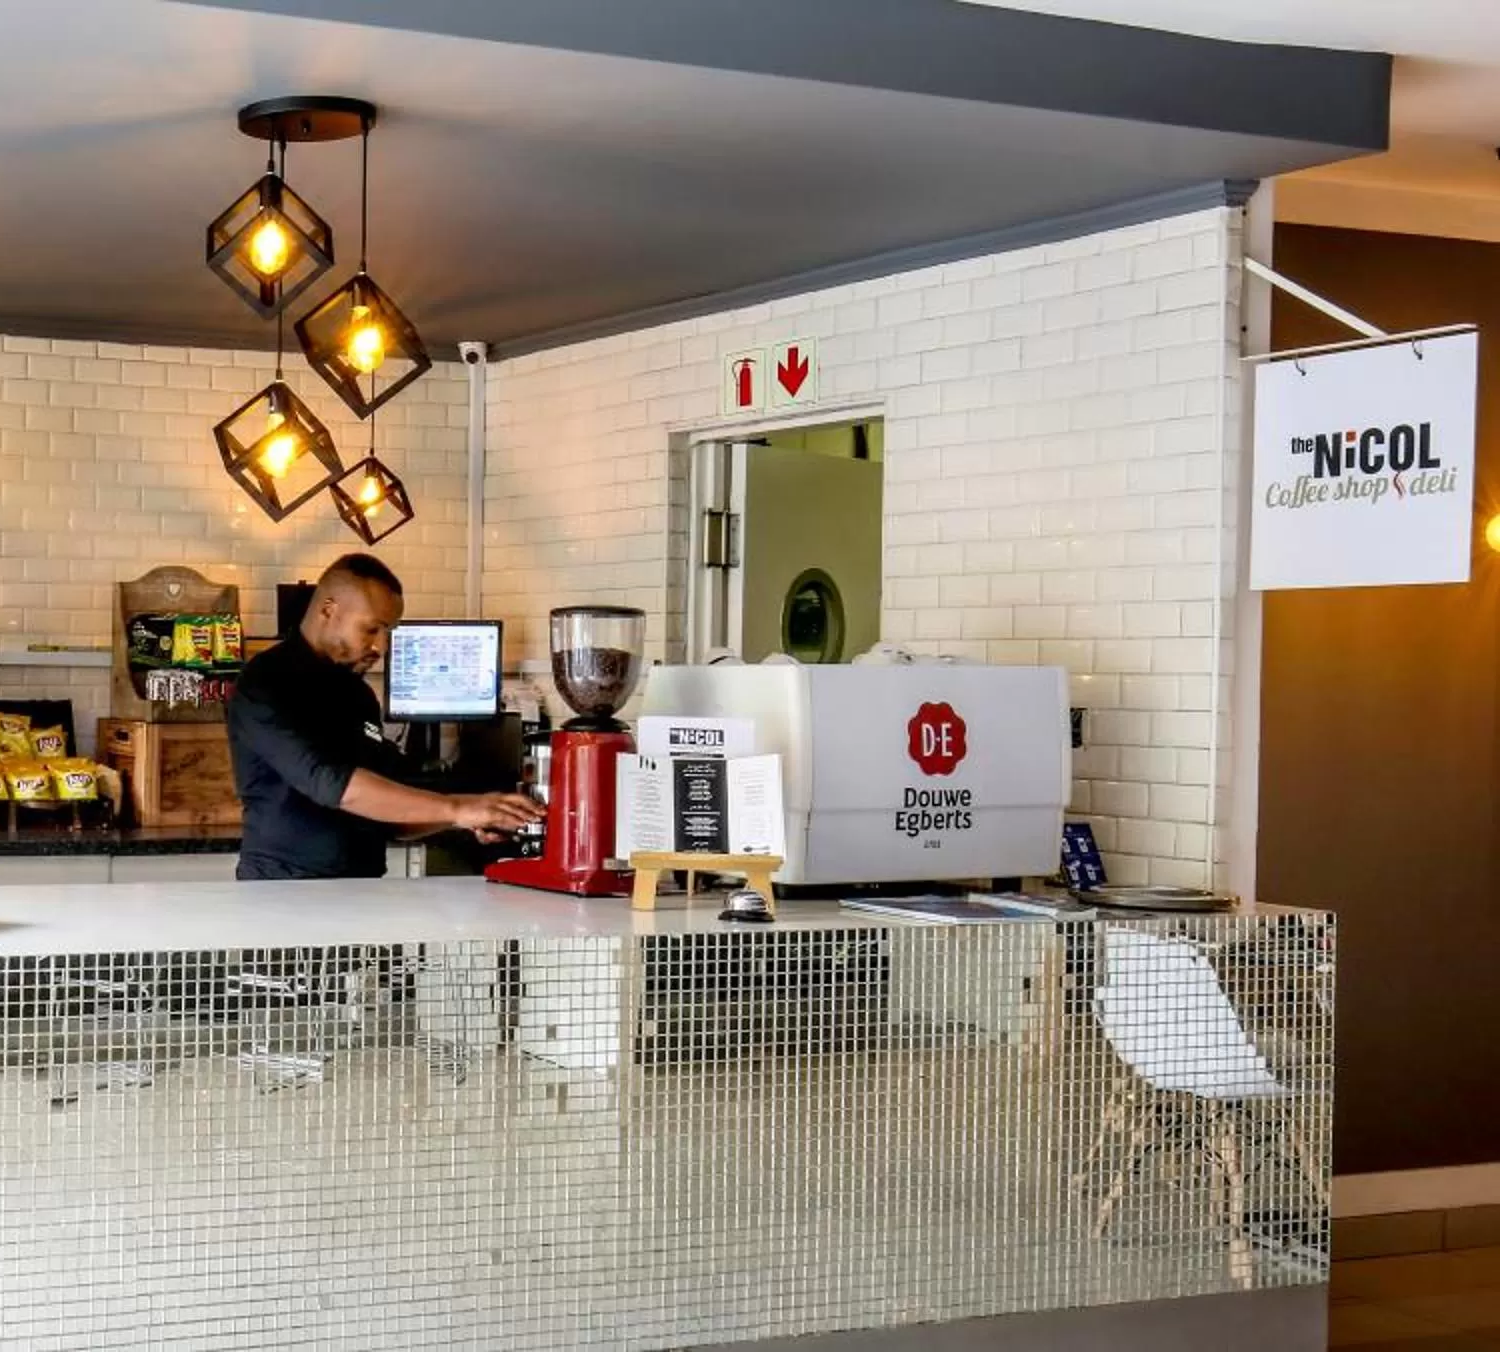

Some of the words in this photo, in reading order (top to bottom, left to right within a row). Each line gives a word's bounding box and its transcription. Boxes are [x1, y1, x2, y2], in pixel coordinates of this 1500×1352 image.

[1291, 436, 1313, 454] the
[1265, 474, 1329, 508] Coffee
[1332, 475, 1389, 505] shop
[1410, 467, 1457, 496] deli
[903, 787, 972, 808] Douwe
[895, 810, 973, 837] Egberts
